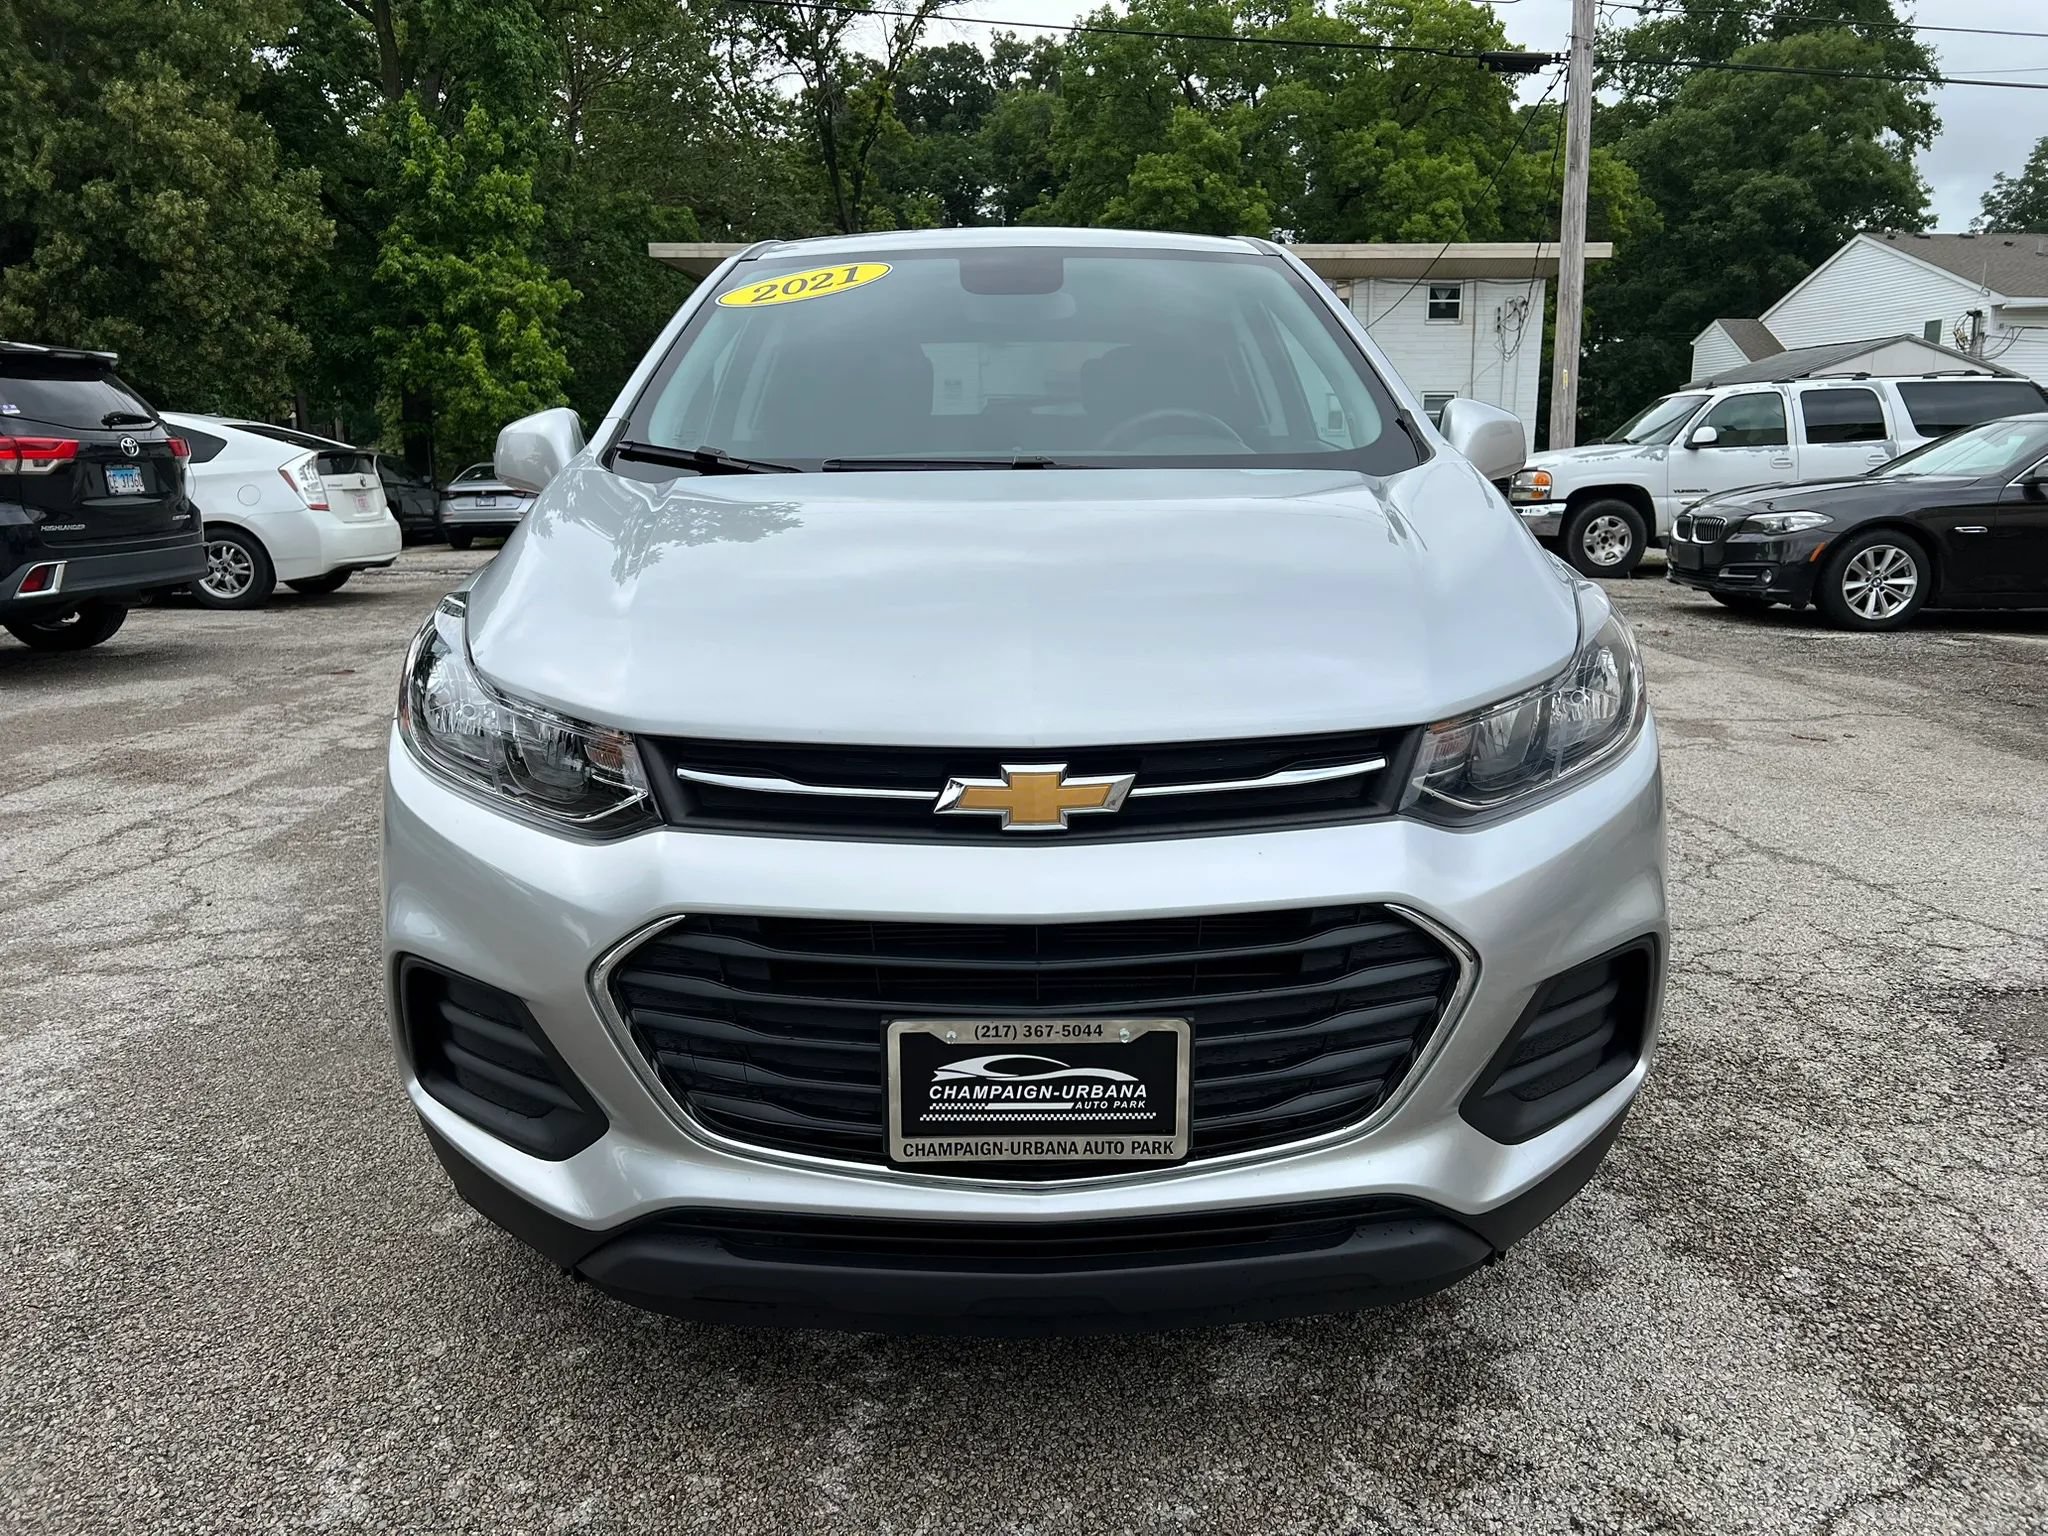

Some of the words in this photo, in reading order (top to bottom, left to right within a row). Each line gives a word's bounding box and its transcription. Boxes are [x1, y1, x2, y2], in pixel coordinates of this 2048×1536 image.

[751, 265, 859, 303] 2021
[974, 1024, 1018, 1041] (217)
[1023, 1024, 1104, 1038] 367-5044
[929, 1084, 1148, 1100] CHAMPAIGN-URBANA
[1075, 1101, 1109, 1110] AUTO
[1113, 1100, 1146, 1109] PARK
[903, 1141, 1080, 1158] CHAMPAIGN-URBANA
[1082, 1141, 1125, 1156] AUTO
[1131, 1140, 1174, 1155] PARK
